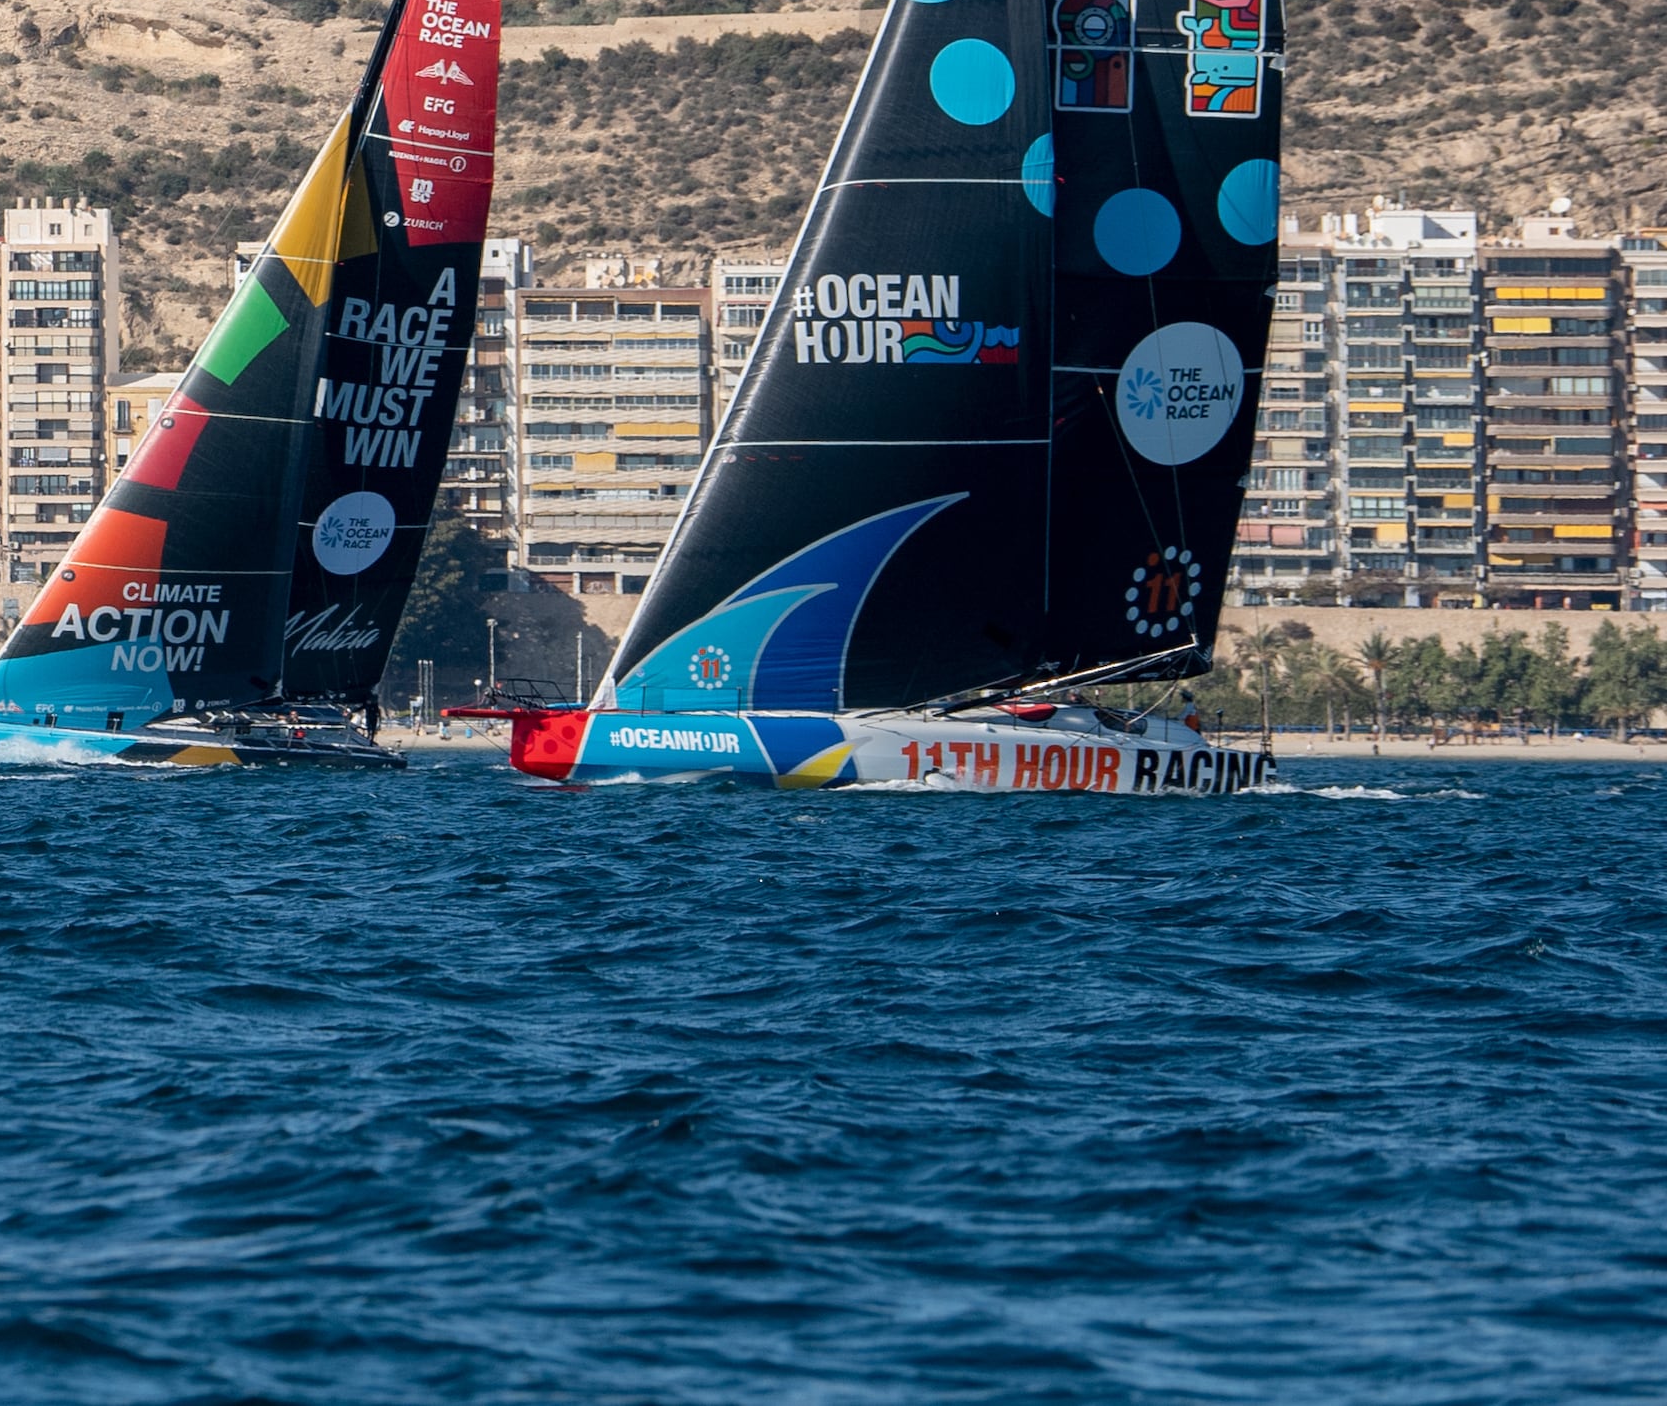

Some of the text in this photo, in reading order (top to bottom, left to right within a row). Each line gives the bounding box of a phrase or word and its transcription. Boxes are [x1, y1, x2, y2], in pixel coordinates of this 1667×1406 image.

[421, 13, 490, 39] OCEAN
[419, 28, 465, 49] RACE
[423, 96, 456, 114] EFG
[418, 125, 470, 141] Hapag-Lloyd
[402, 217, 444, 231] ZURICH
[427, 267, 456, 307] A
[793, 273, 959, 319] #OCEAN
[338, 296, 454, 346] RACE
[794, 320, 904, 364] HOUR
[380, 345, 443, 387] WE
[1169, 368, 1202, 382] THE
[313, 377, 434, 427] MUST
[1167, 383, 1235, 403] OCEAN
[1166, 404, 1210, 420] RACE
[344, 426, 422, 469] WIN
[346, 527, 390, 540] OCEAN
[348, 517, 371, 527] THE
[342, 539, 372, 550] RACE
[122, 581, 222, 603] CLIMATE
[51, 602, 230, 644] ACTION
[110, 644, 205, 673] NOW!
[700, 659, 720, 679] 11
[610, 726, 741, 754] #OCEANHOUR
[901, 740, 1278, 793] 11TH HOUR RACING
